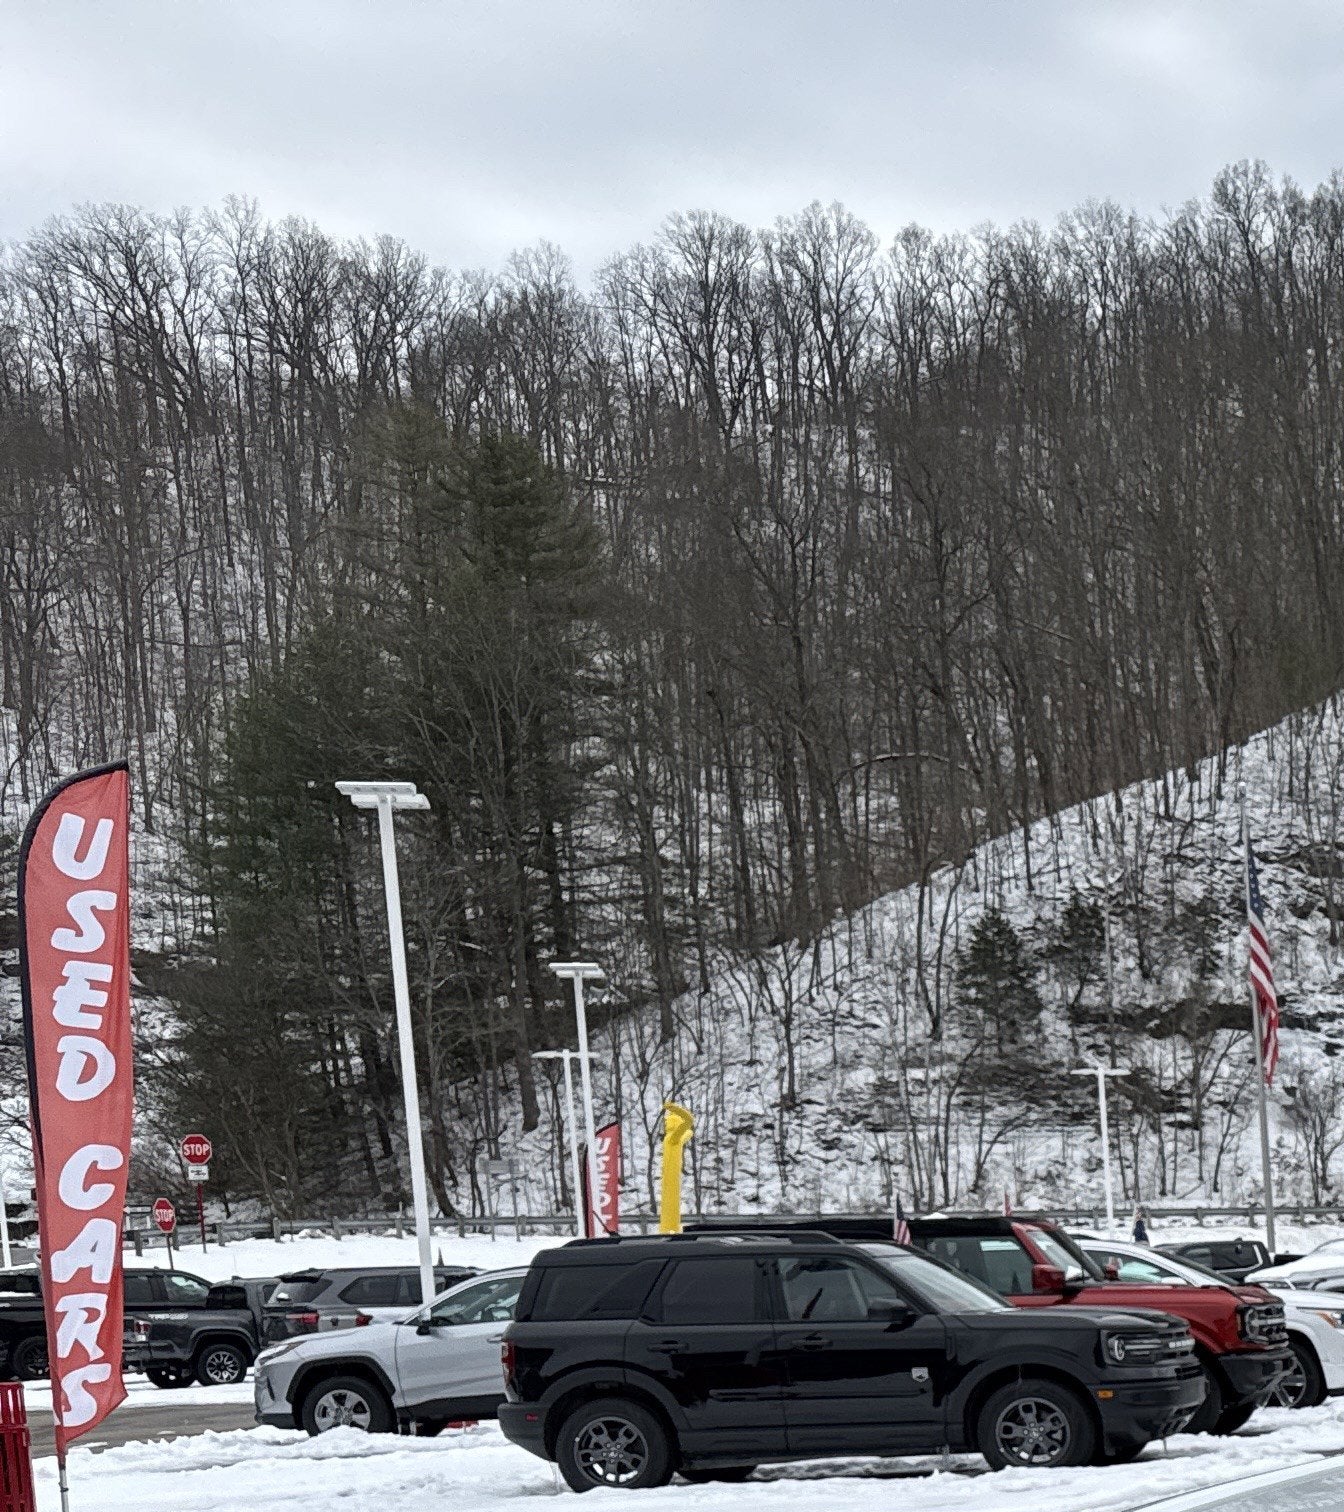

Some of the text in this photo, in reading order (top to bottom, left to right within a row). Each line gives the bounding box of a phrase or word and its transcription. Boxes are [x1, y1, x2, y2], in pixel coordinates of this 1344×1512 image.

[51, 812, 122, 1428] USED CARS
[183, 1143, 210, 1156] STOP
[155, 1208, 174, 1222] STOP
